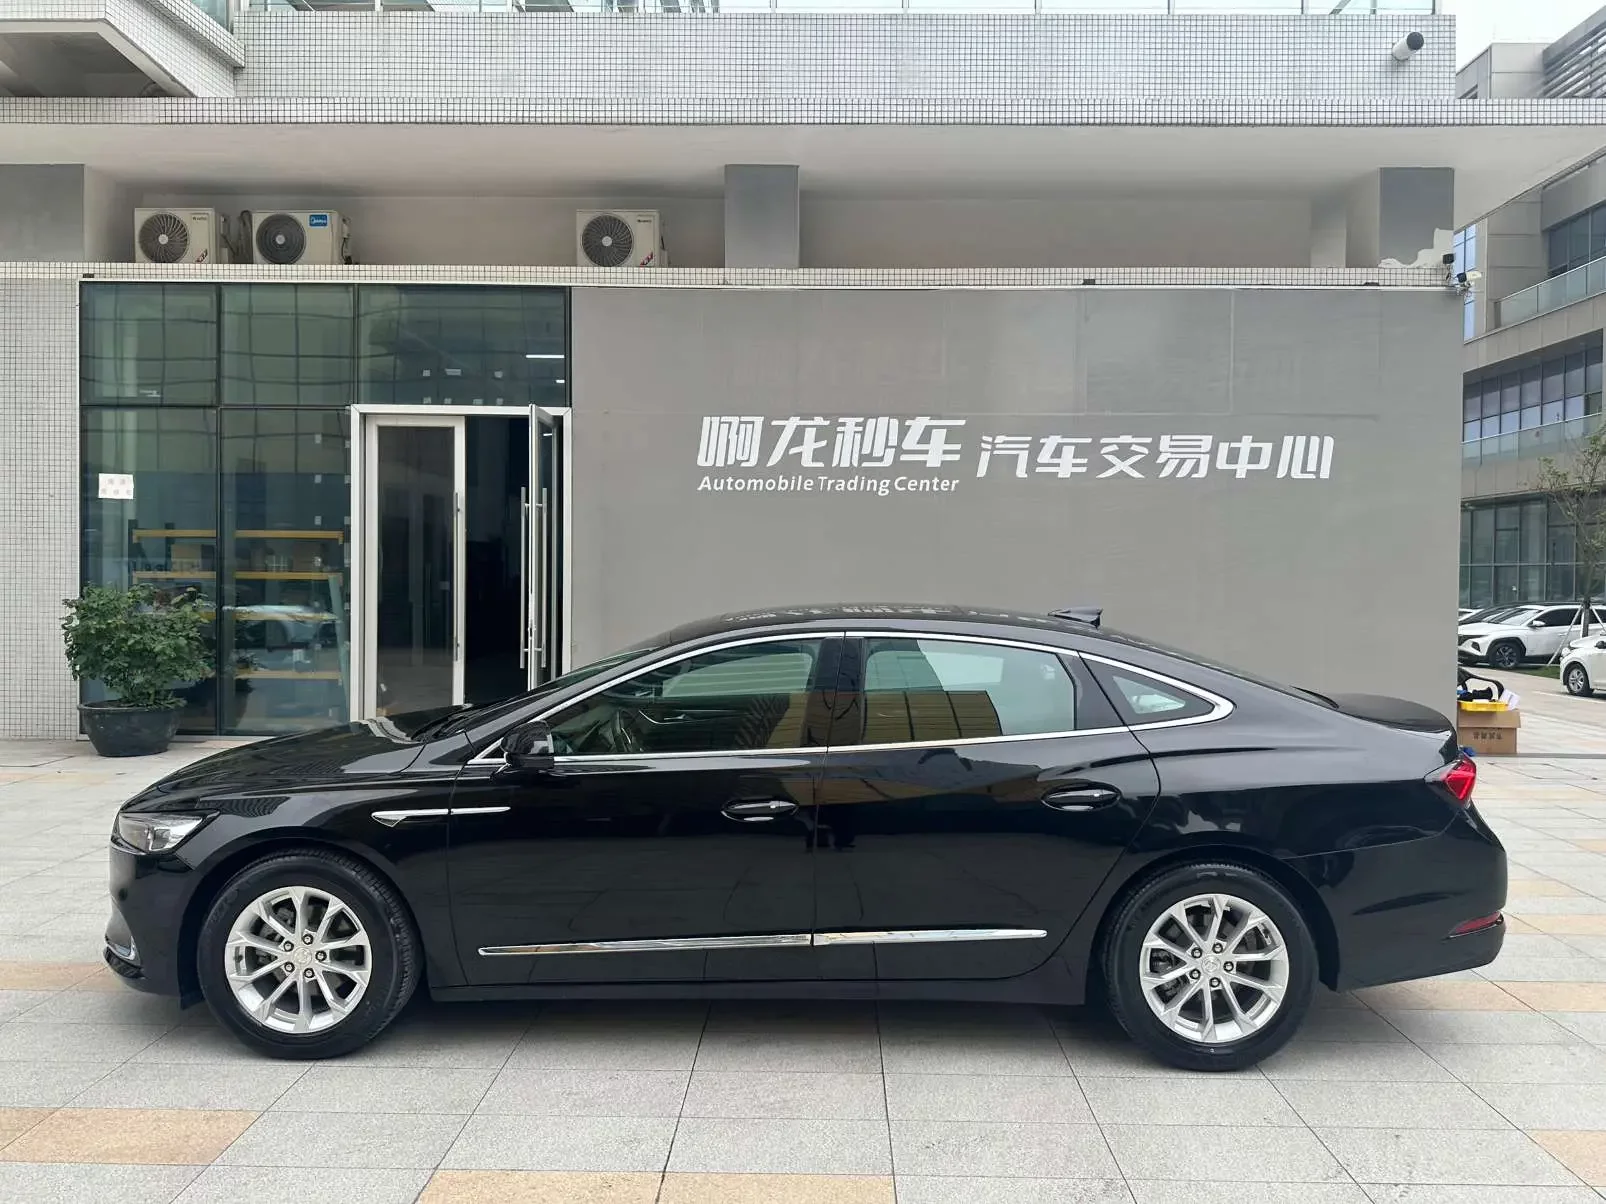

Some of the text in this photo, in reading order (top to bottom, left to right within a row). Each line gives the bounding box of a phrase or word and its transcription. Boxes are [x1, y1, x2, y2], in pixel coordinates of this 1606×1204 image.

[697, 416, 1335, 479] 啊龙秒车 汽车交易中心
[697, 475, 960, 496] Automobile Trading Center
